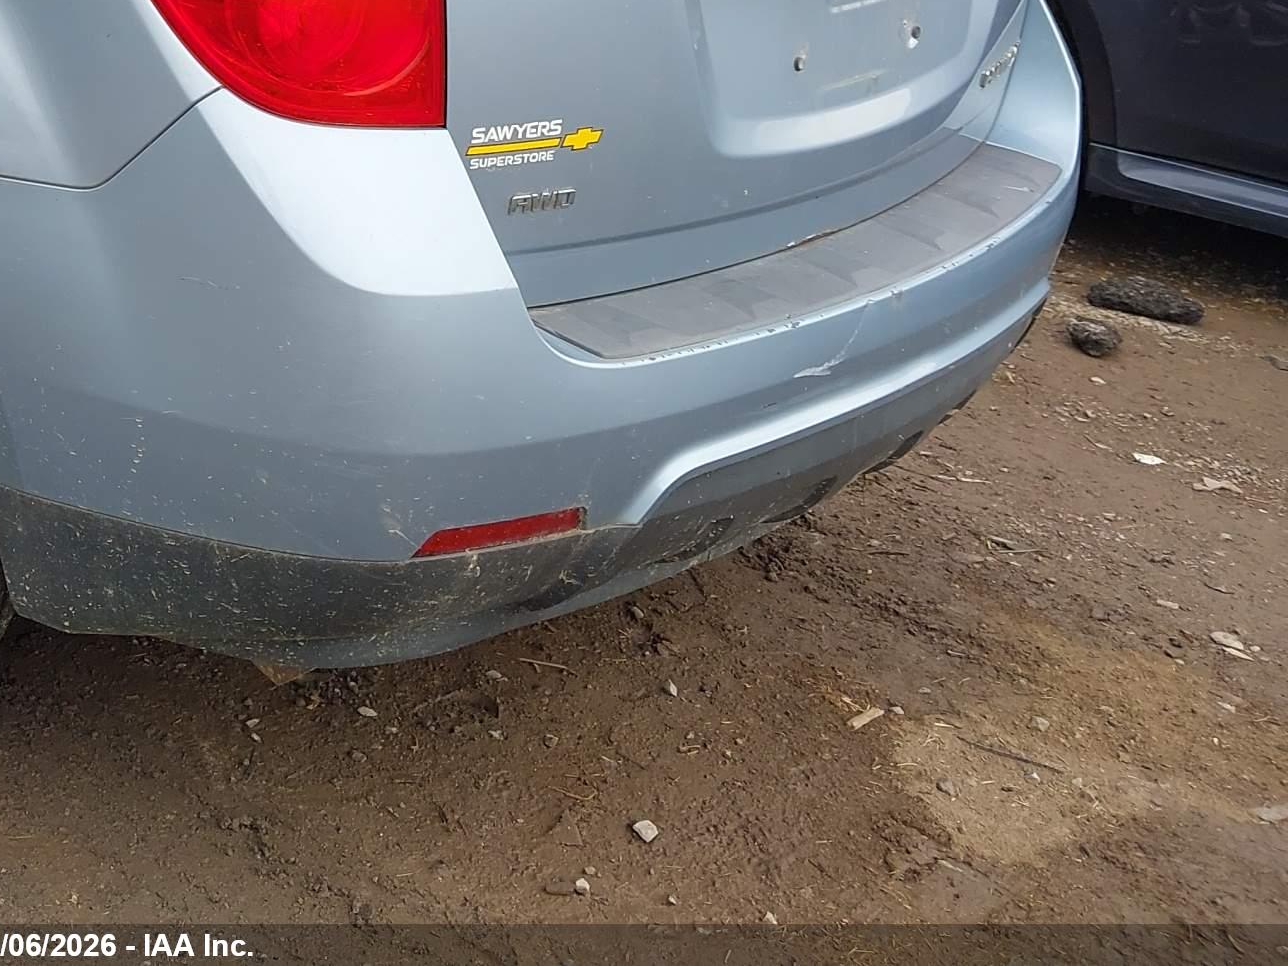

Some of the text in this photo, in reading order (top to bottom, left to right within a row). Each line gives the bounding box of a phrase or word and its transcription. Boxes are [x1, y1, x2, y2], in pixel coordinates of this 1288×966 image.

[471, 119, 563, 144] SAWYERS
[469, 150, 555, 170] SUPERSTORE
[508, 188, 576, 216] AWD
